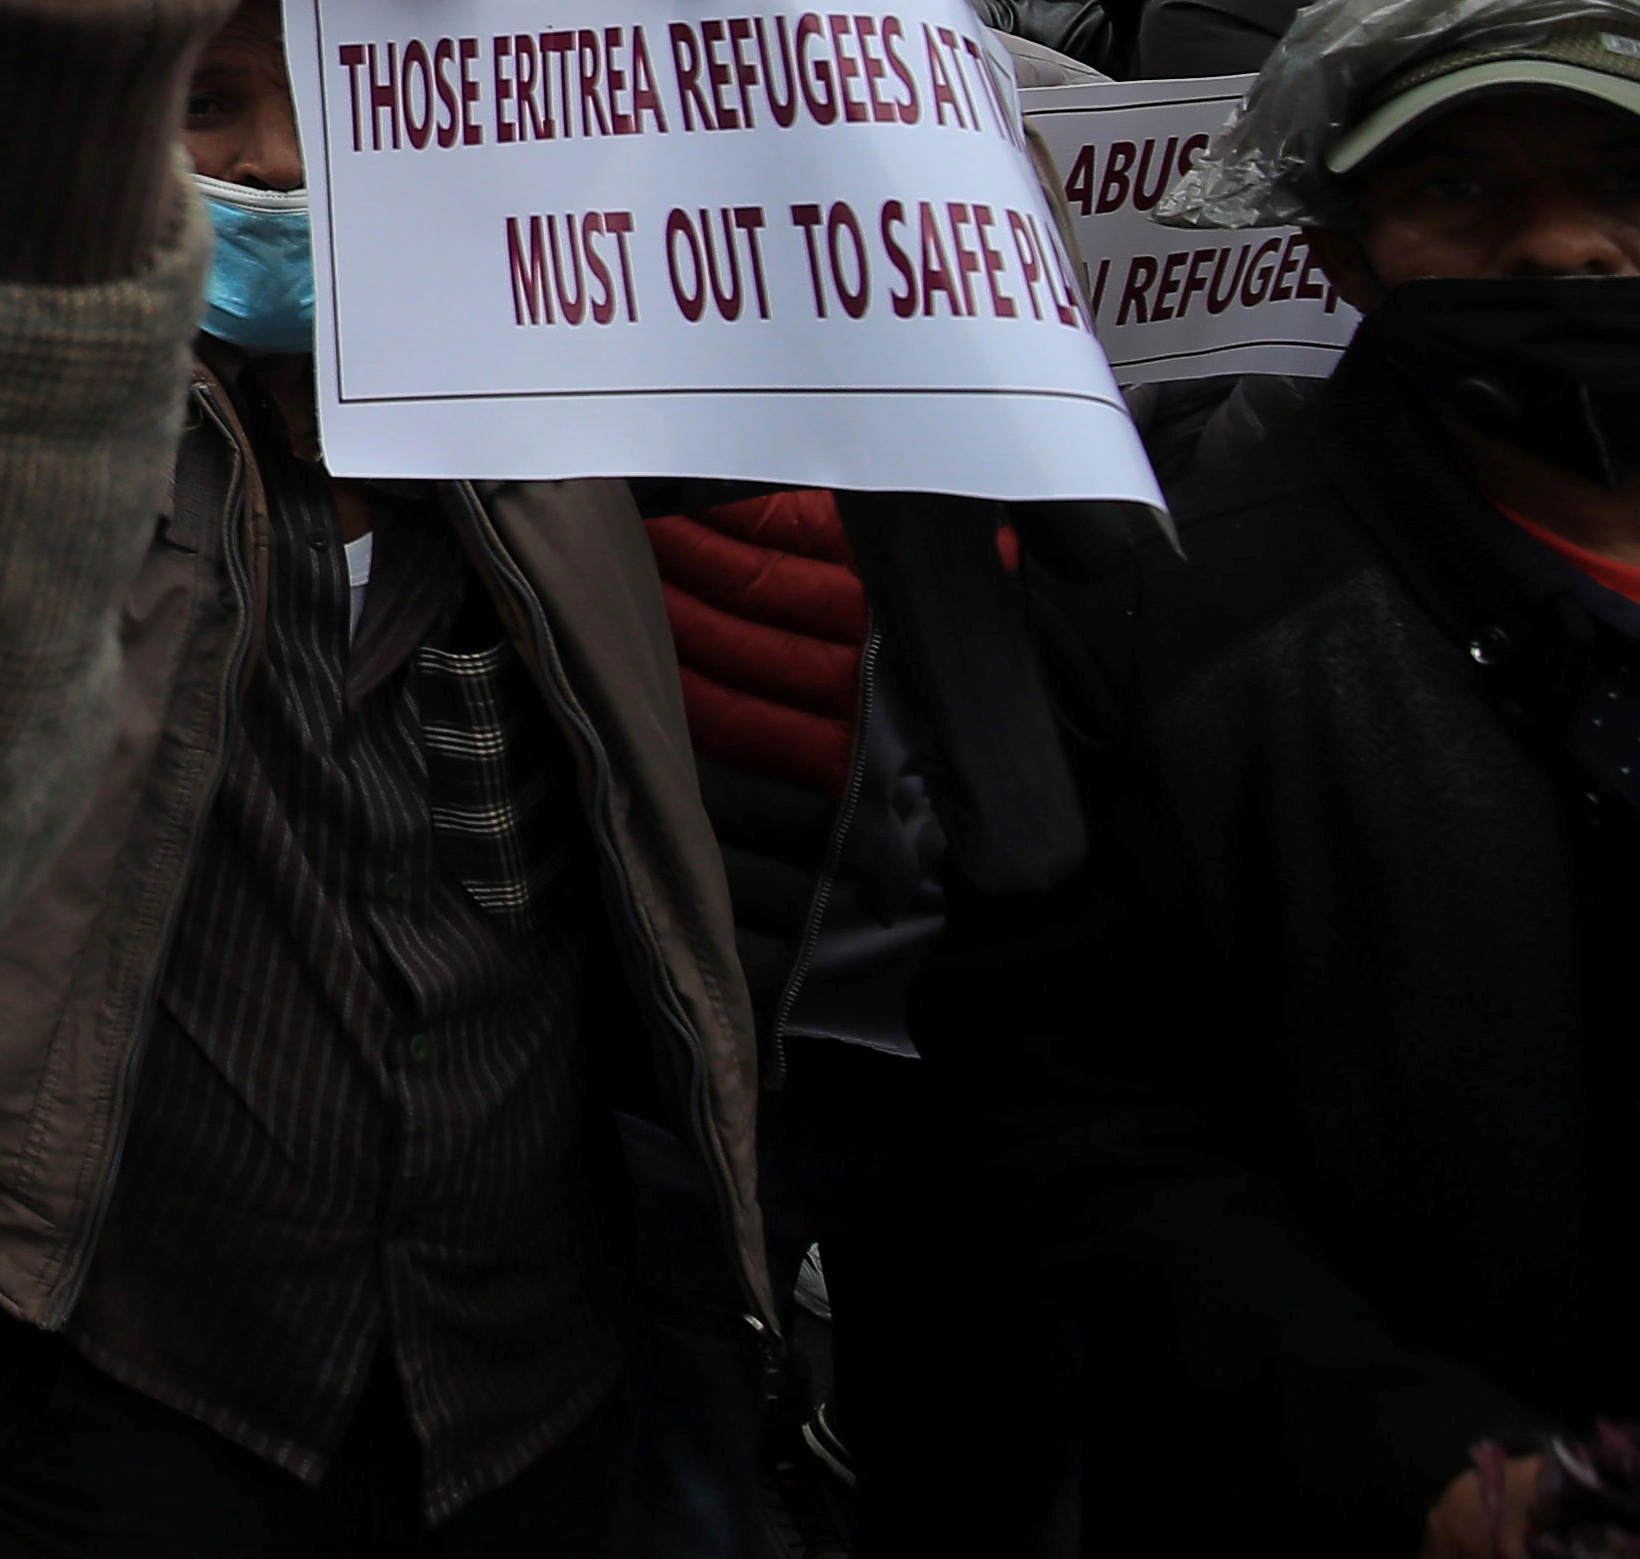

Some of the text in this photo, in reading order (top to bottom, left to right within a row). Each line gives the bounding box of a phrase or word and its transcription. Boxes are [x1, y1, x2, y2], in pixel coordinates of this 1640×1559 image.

[340, 38, 482, 152] THOSE
[494, 26, 668, 143] ERITREA
[670, 14, 921, 131] REFUGEES
[1065, 133, 1210, 217] ABUS
[507, 210, 639, 327] MUST
[667, 206, 772, 322] OUT
[792, 200, 871, 321] TO
[882, 200, 1018, 319] SAFE
